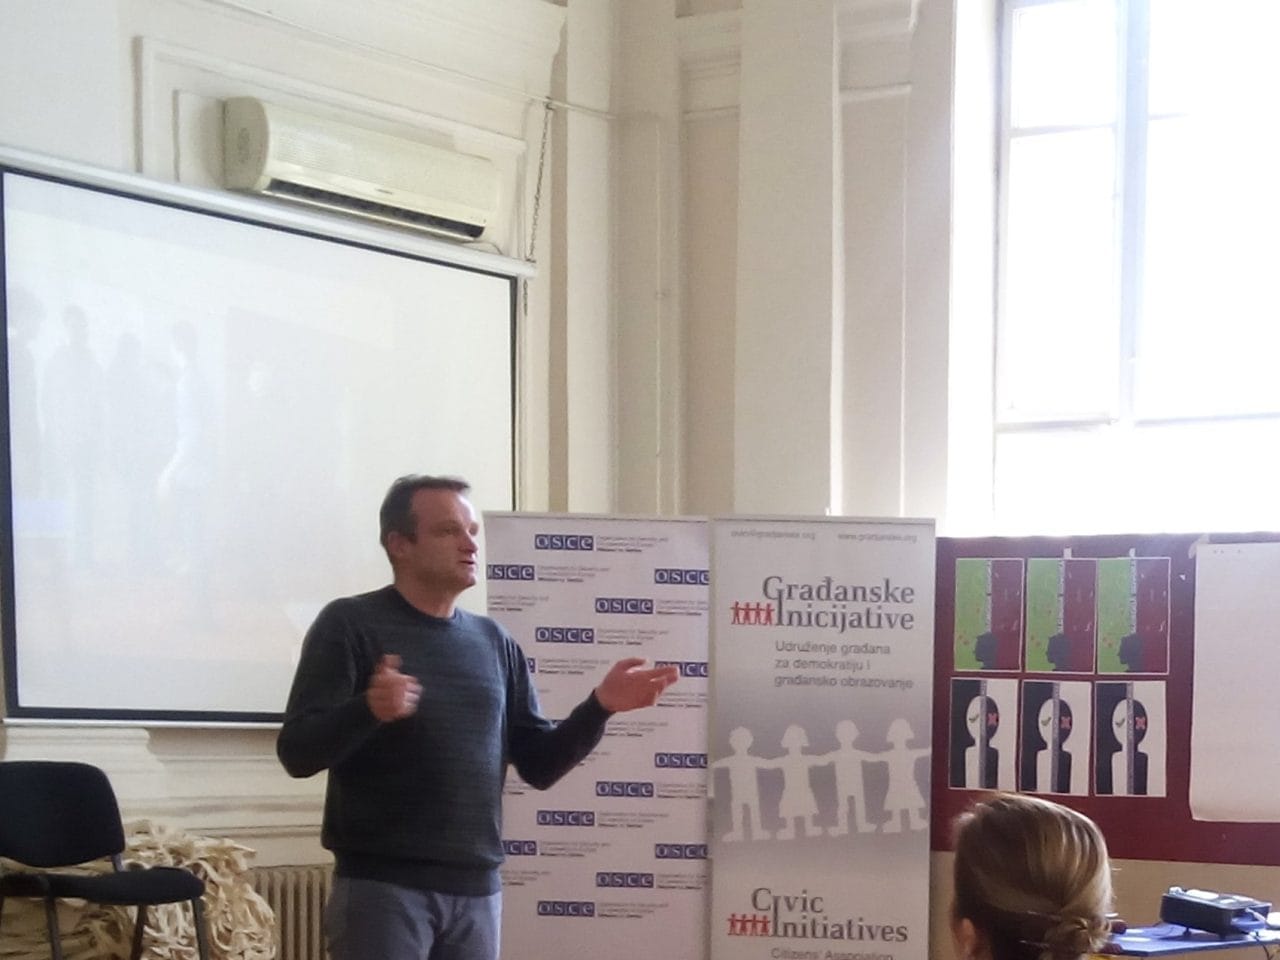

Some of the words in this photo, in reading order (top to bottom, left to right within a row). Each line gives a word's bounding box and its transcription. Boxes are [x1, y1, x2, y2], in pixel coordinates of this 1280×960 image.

[763, 576, 914, 603] Građanske
[776, 589, 914, 633] Inicijative
[775, 659, 789, 669] za
[752, 887, 824, 913] Civic
[772, 896, 908, 942] Initiatives
